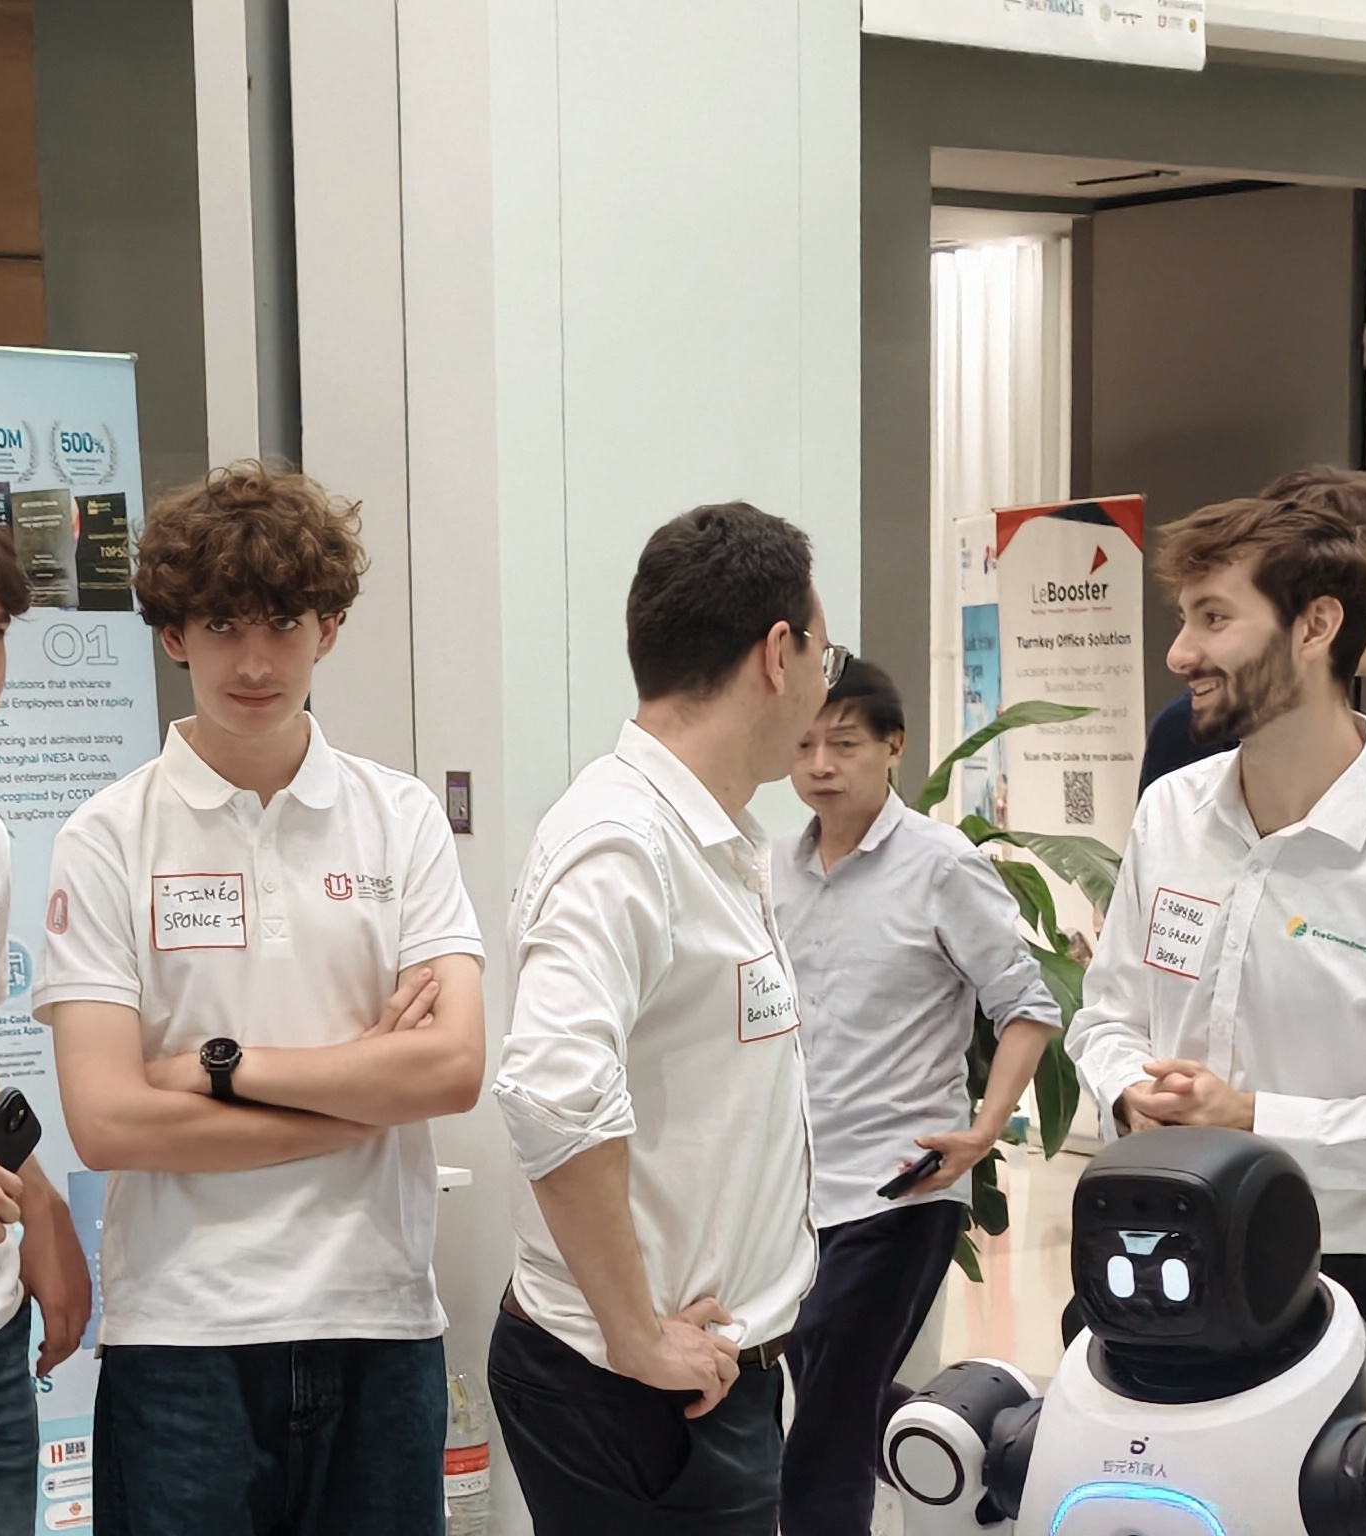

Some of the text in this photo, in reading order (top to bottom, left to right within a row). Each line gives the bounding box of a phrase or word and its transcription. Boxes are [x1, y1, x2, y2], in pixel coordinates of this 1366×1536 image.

[60, 432, 105, 454] 500%
[1031, 581, 1109, 604] LeBooster
[1017, 631, 1132, 650] Turnkey Office Solution
[48, 679, 67, 689] that
[69, 679, 112, 689] enhance
[11, 698, 65, 710] Employees
[67, 699, 84, 707] can
[87, 698, 99, 707] be
[101, 697, 134, 709] rapidly
[29, 735, 47, 745] and
[49, 734, 92, 745] achieved
[94, 734, 123, 745] strong
[42, 752, 75, 763] INESA
[14, 771, 67, 784] enterprises
[51, 789, 64, 802] by
[173, 881, 239, 902] TIMÉO
[164, 912, 222, 931] SPONGE
